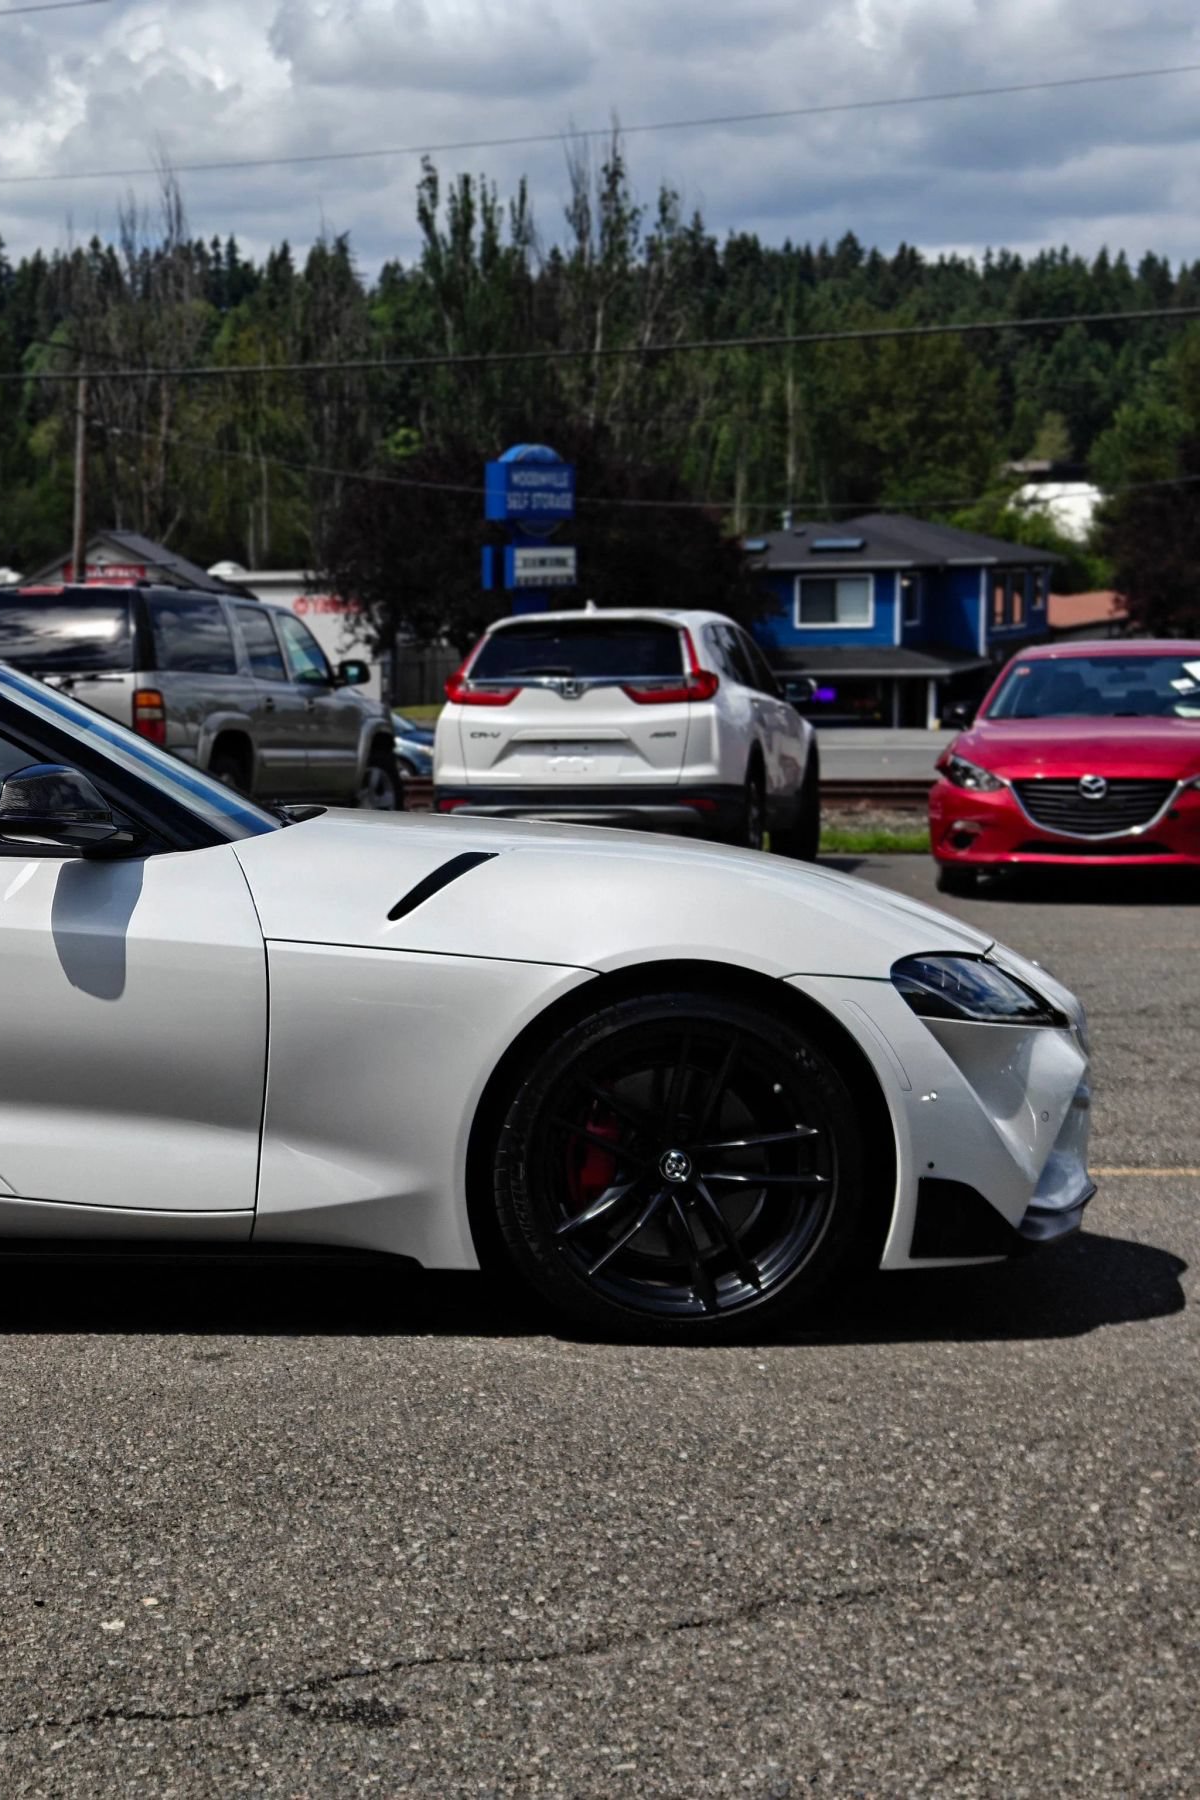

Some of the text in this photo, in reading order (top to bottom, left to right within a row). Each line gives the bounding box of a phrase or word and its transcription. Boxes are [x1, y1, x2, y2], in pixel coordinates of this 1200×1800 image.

[507, 492, 573, 510] SELF STORAGE
[470, 731, 502, 740] CR-V
[649, 731, 678, 739] AWD
